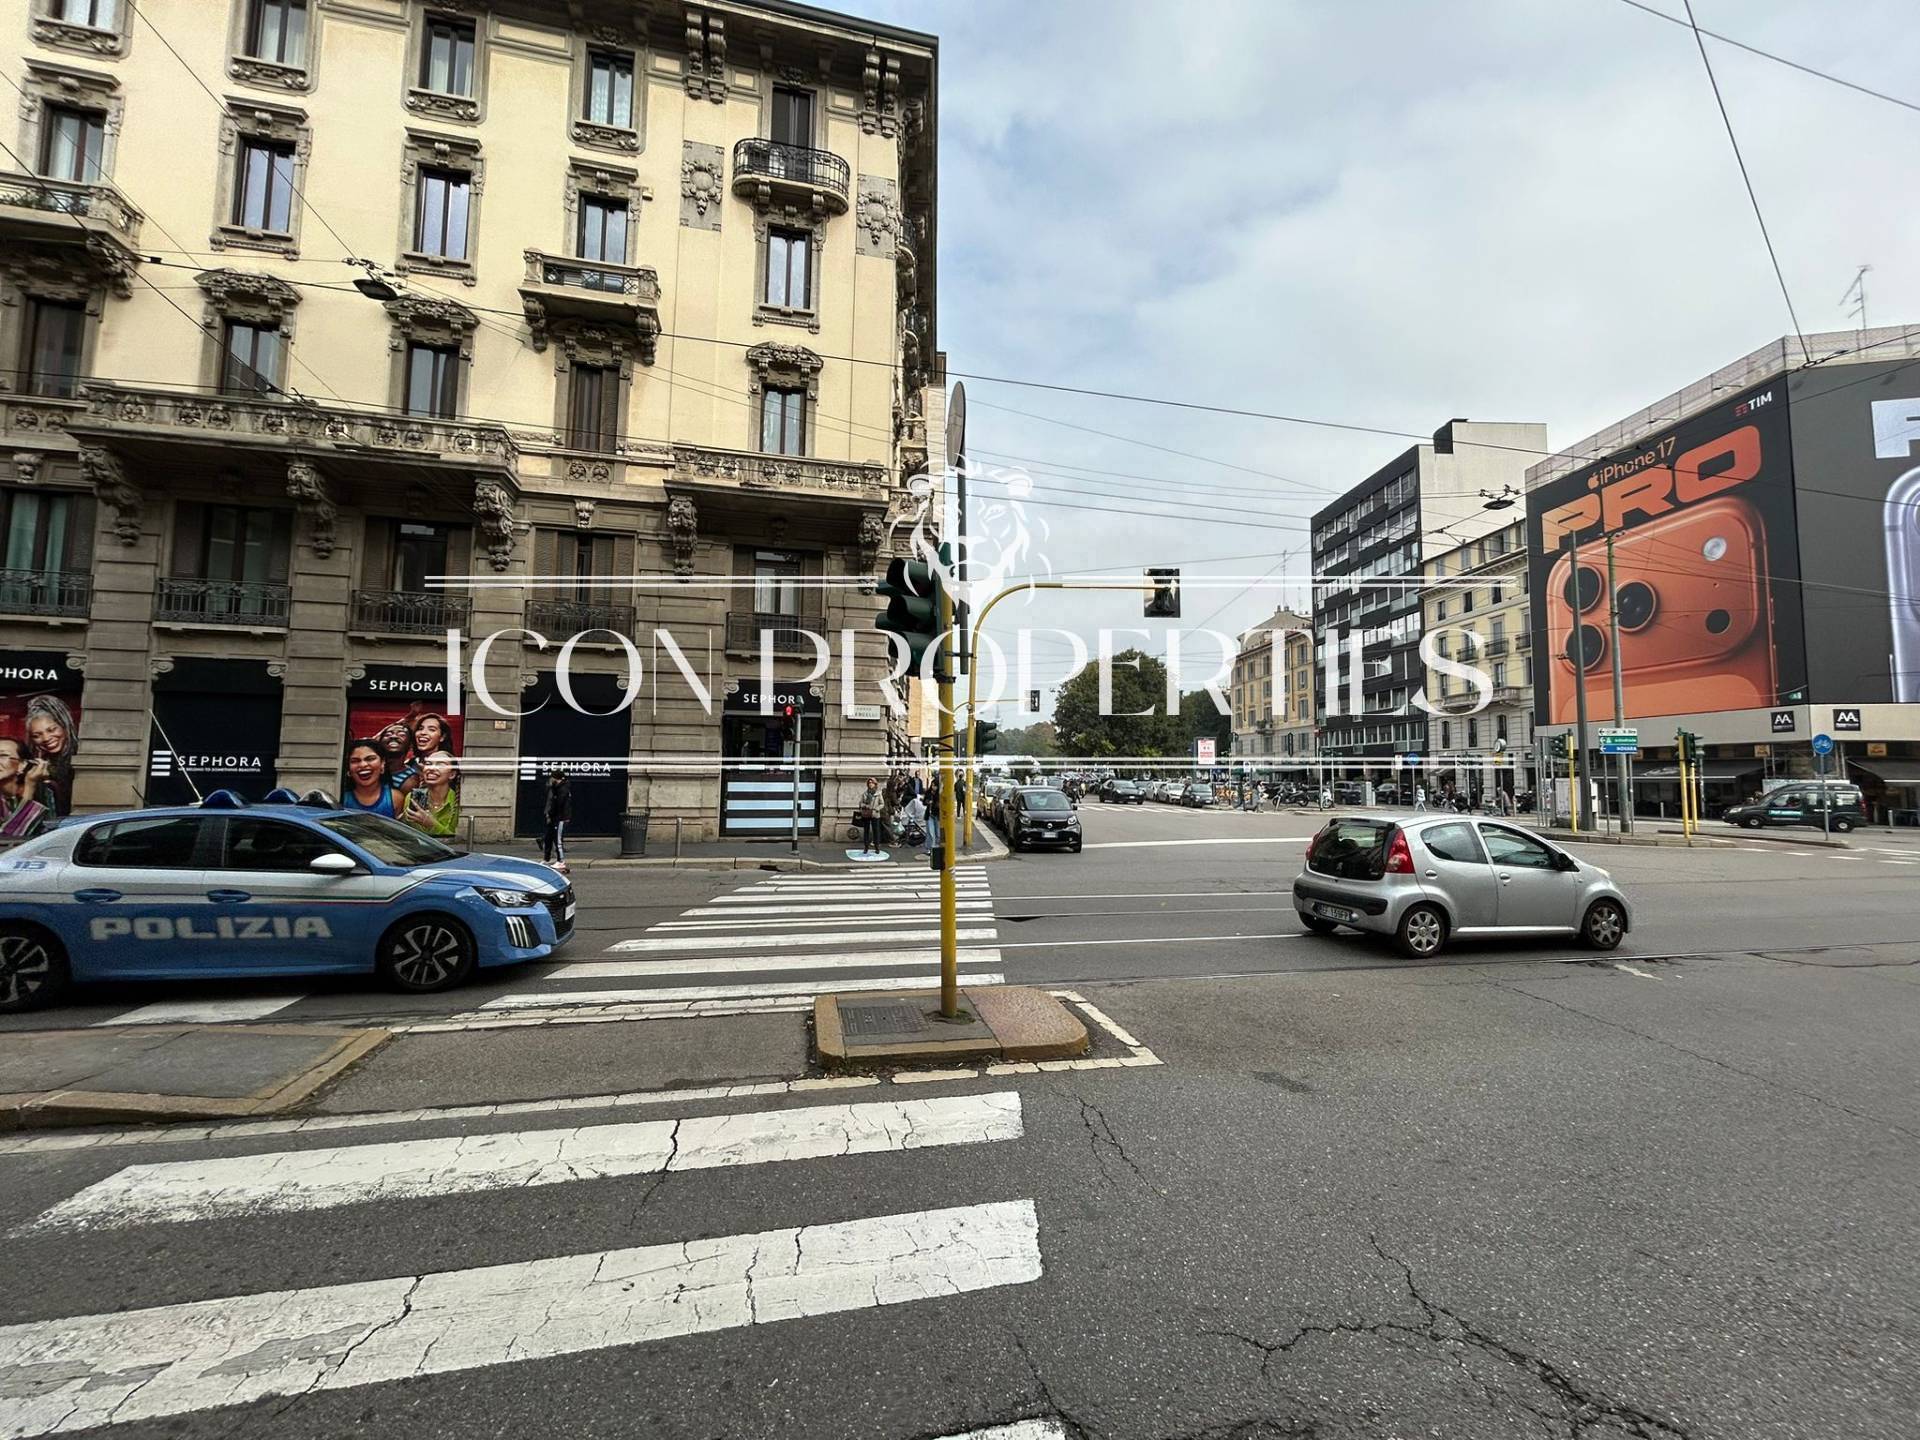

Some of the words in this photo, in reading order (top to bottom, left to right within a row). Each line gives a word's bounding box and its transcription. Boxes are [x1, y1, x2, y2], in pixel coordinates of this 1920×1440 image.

[1747, 391, 1773, 411] TIM
[1600, 452, 1656, 485] iPhone
[1656, 436, 1677, 459] 17
[1541, 425, 1762, 555] PRO
[369, 679, 444, 693] SEPHORA
[178, 755, 262, 767] SEPHORA
[542, 761, 611, 772] SEPHORA
[89, 916, 333, 941] POLIZIA
